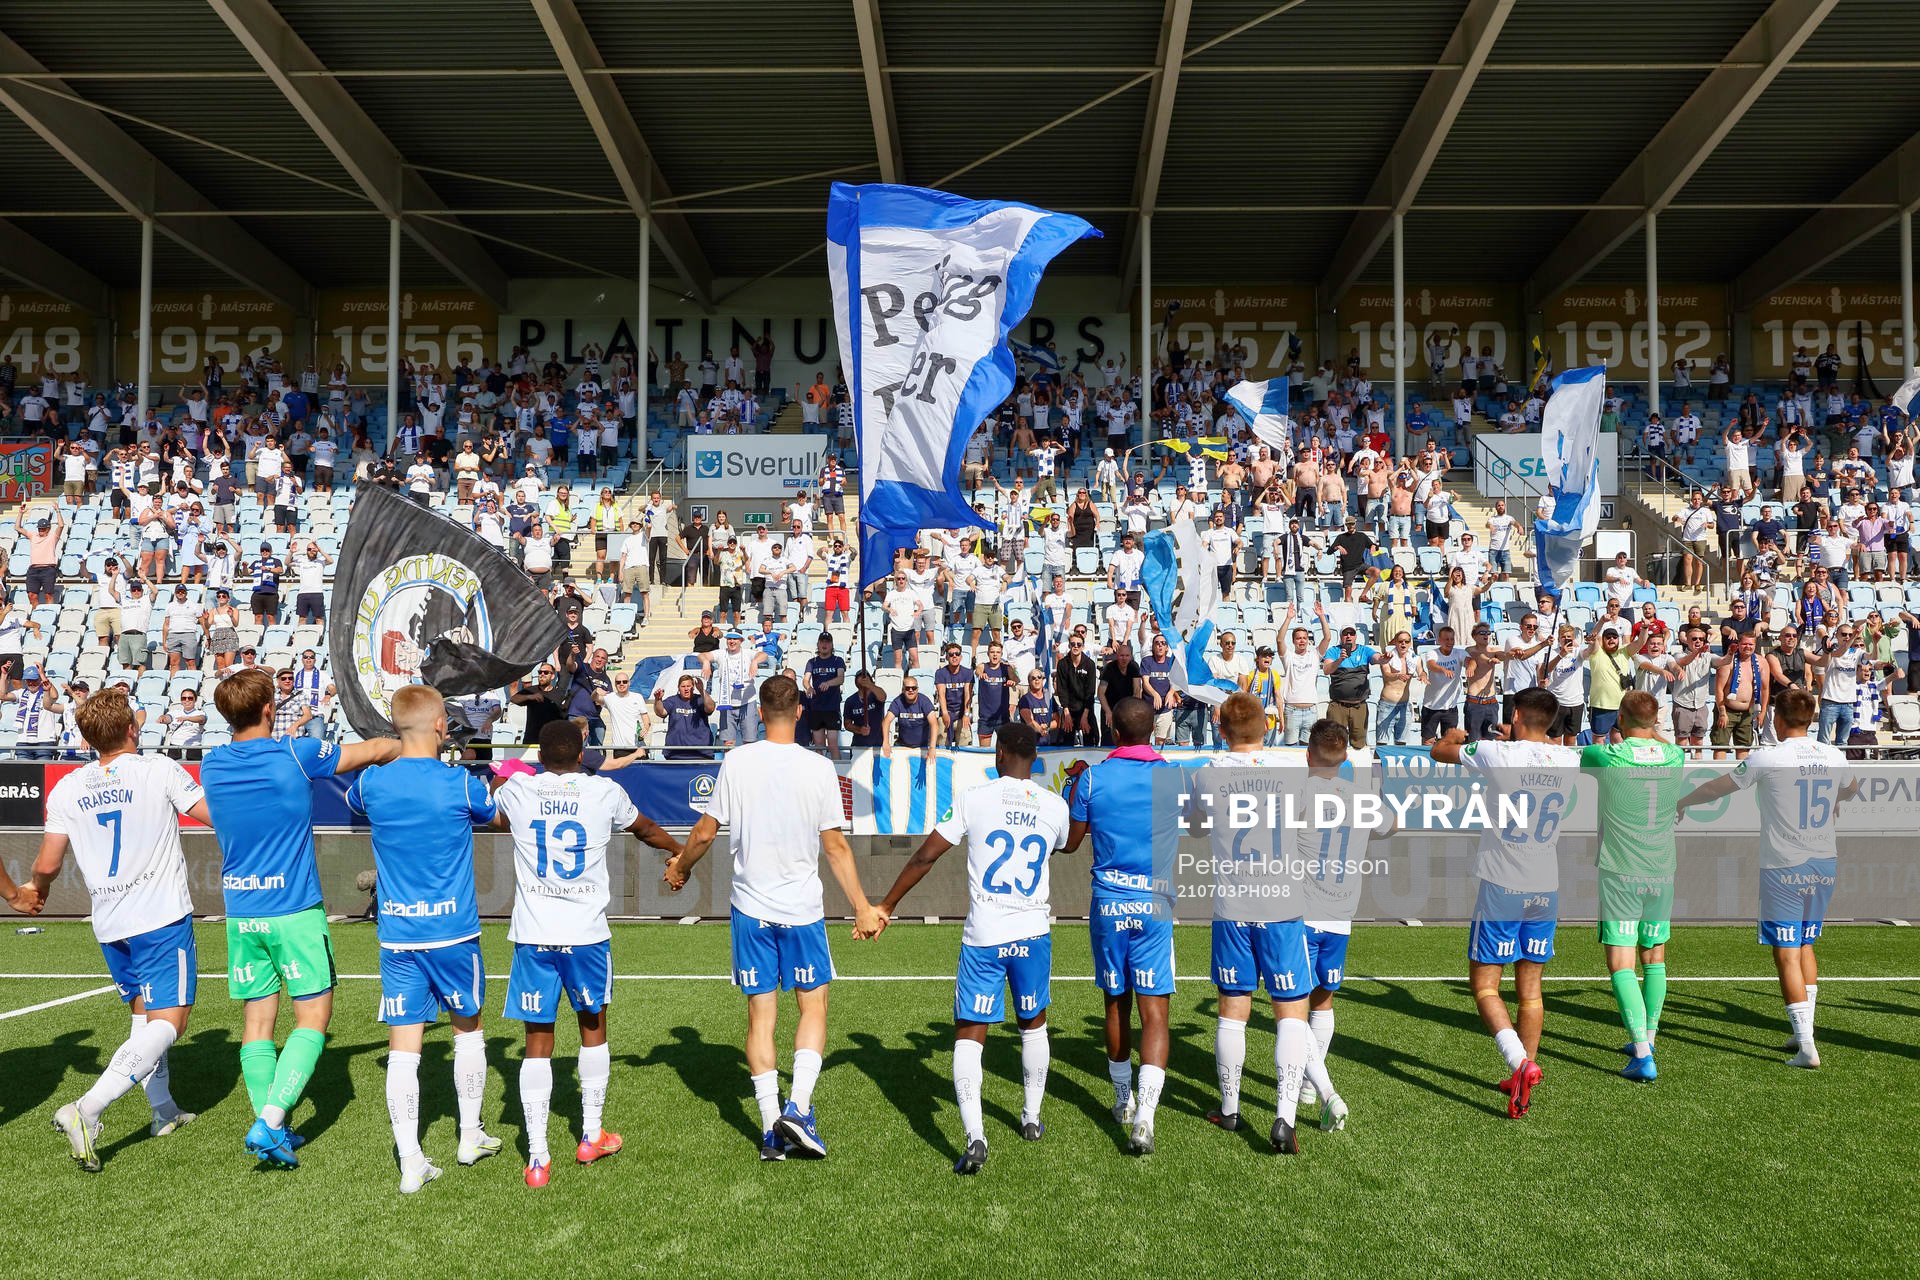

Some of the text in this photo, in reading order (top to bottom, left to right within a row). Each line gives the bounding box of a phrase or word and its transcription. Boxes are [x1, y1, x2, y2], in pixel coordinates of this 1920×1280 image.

[19, 301, 73, 313] MÄSTARE
[150, 301, 275, 313] VENSKA MÄSTARE
[421, 301, 477, 312] MÄSTARE
[1233, 297, 1288, 308] MÄSTARE
[1440, 296, 1496, 307] MÄSTARE
[1564, 297, 1617, 307] SVENSKA
[1770, 295, 1822, 306] SVENSKA
[0, 326, 81, 373] 48
[332, 325, 483, 372] 1956
[726, 451, 818, 477] Sverull
[540, 801, 578, 816] ISHAQ
[1644, 780, 1658, 829] 1
[1794, 779, 1833, 829] 15
[1006, 811, 1037, 829] SEMA
[1501, 789, 1565, 843] 26
[96, 810, 122, 877] 7
[528, 819, 588, 879] 13
[982, 829, 1047, 897] 23
[223, 873, 285, 891] stadium
[1102, 869, 1169, 892] stadium
[381, 896, 456, 917] stadium
[1100, 901, 1162, 916] MÅNSSON
[238, 919, 271, 934] RÖR
[1115, 916, 1143, 932] RÖR
[998, 943, 1030, 959] RÖR
